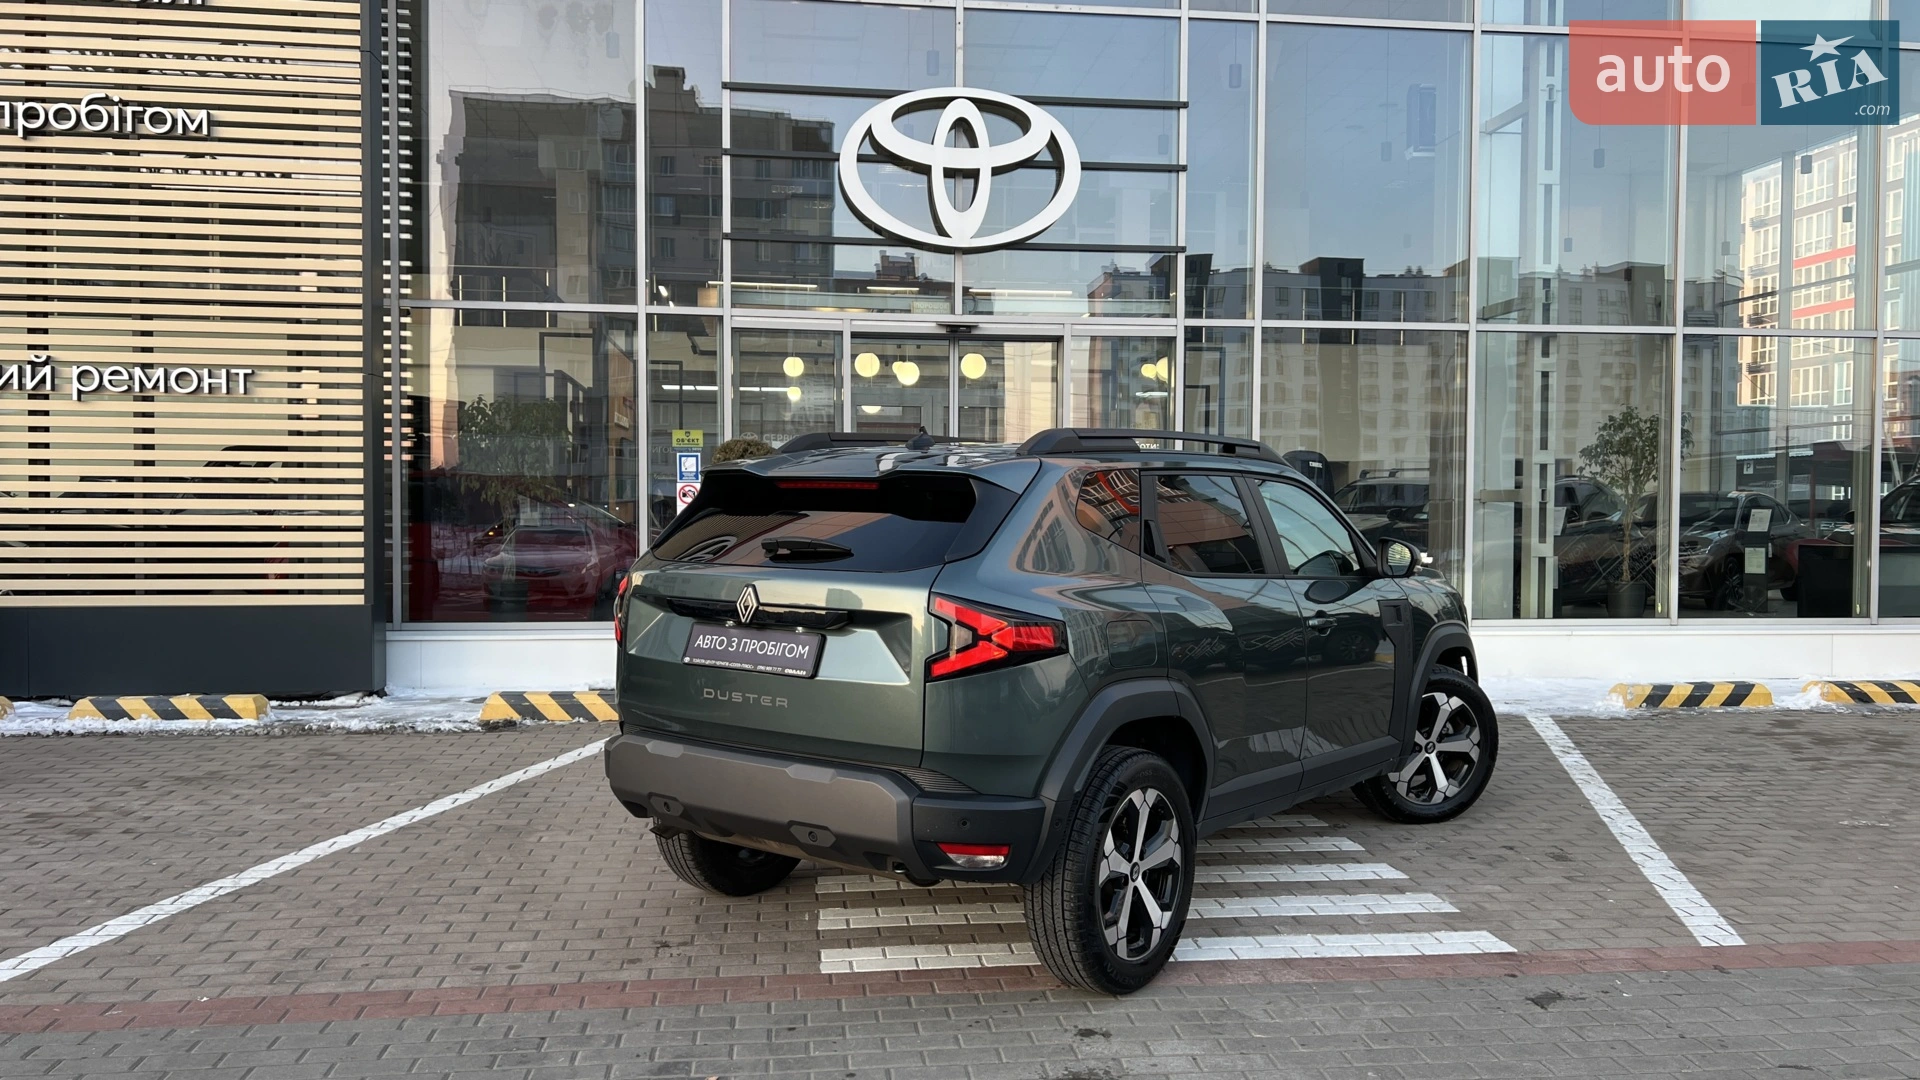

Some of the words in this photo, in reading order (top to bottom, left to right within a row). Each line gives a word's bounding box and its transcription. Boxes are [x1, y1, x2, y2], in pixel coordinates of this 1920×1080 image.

[71, 364, 254, 400] ремонт
[694, 635, 727, 650] АВТО
[739, 639, 809, 659] ПРОБІГОМ
[703, 688, 789, 708] DUSTER
